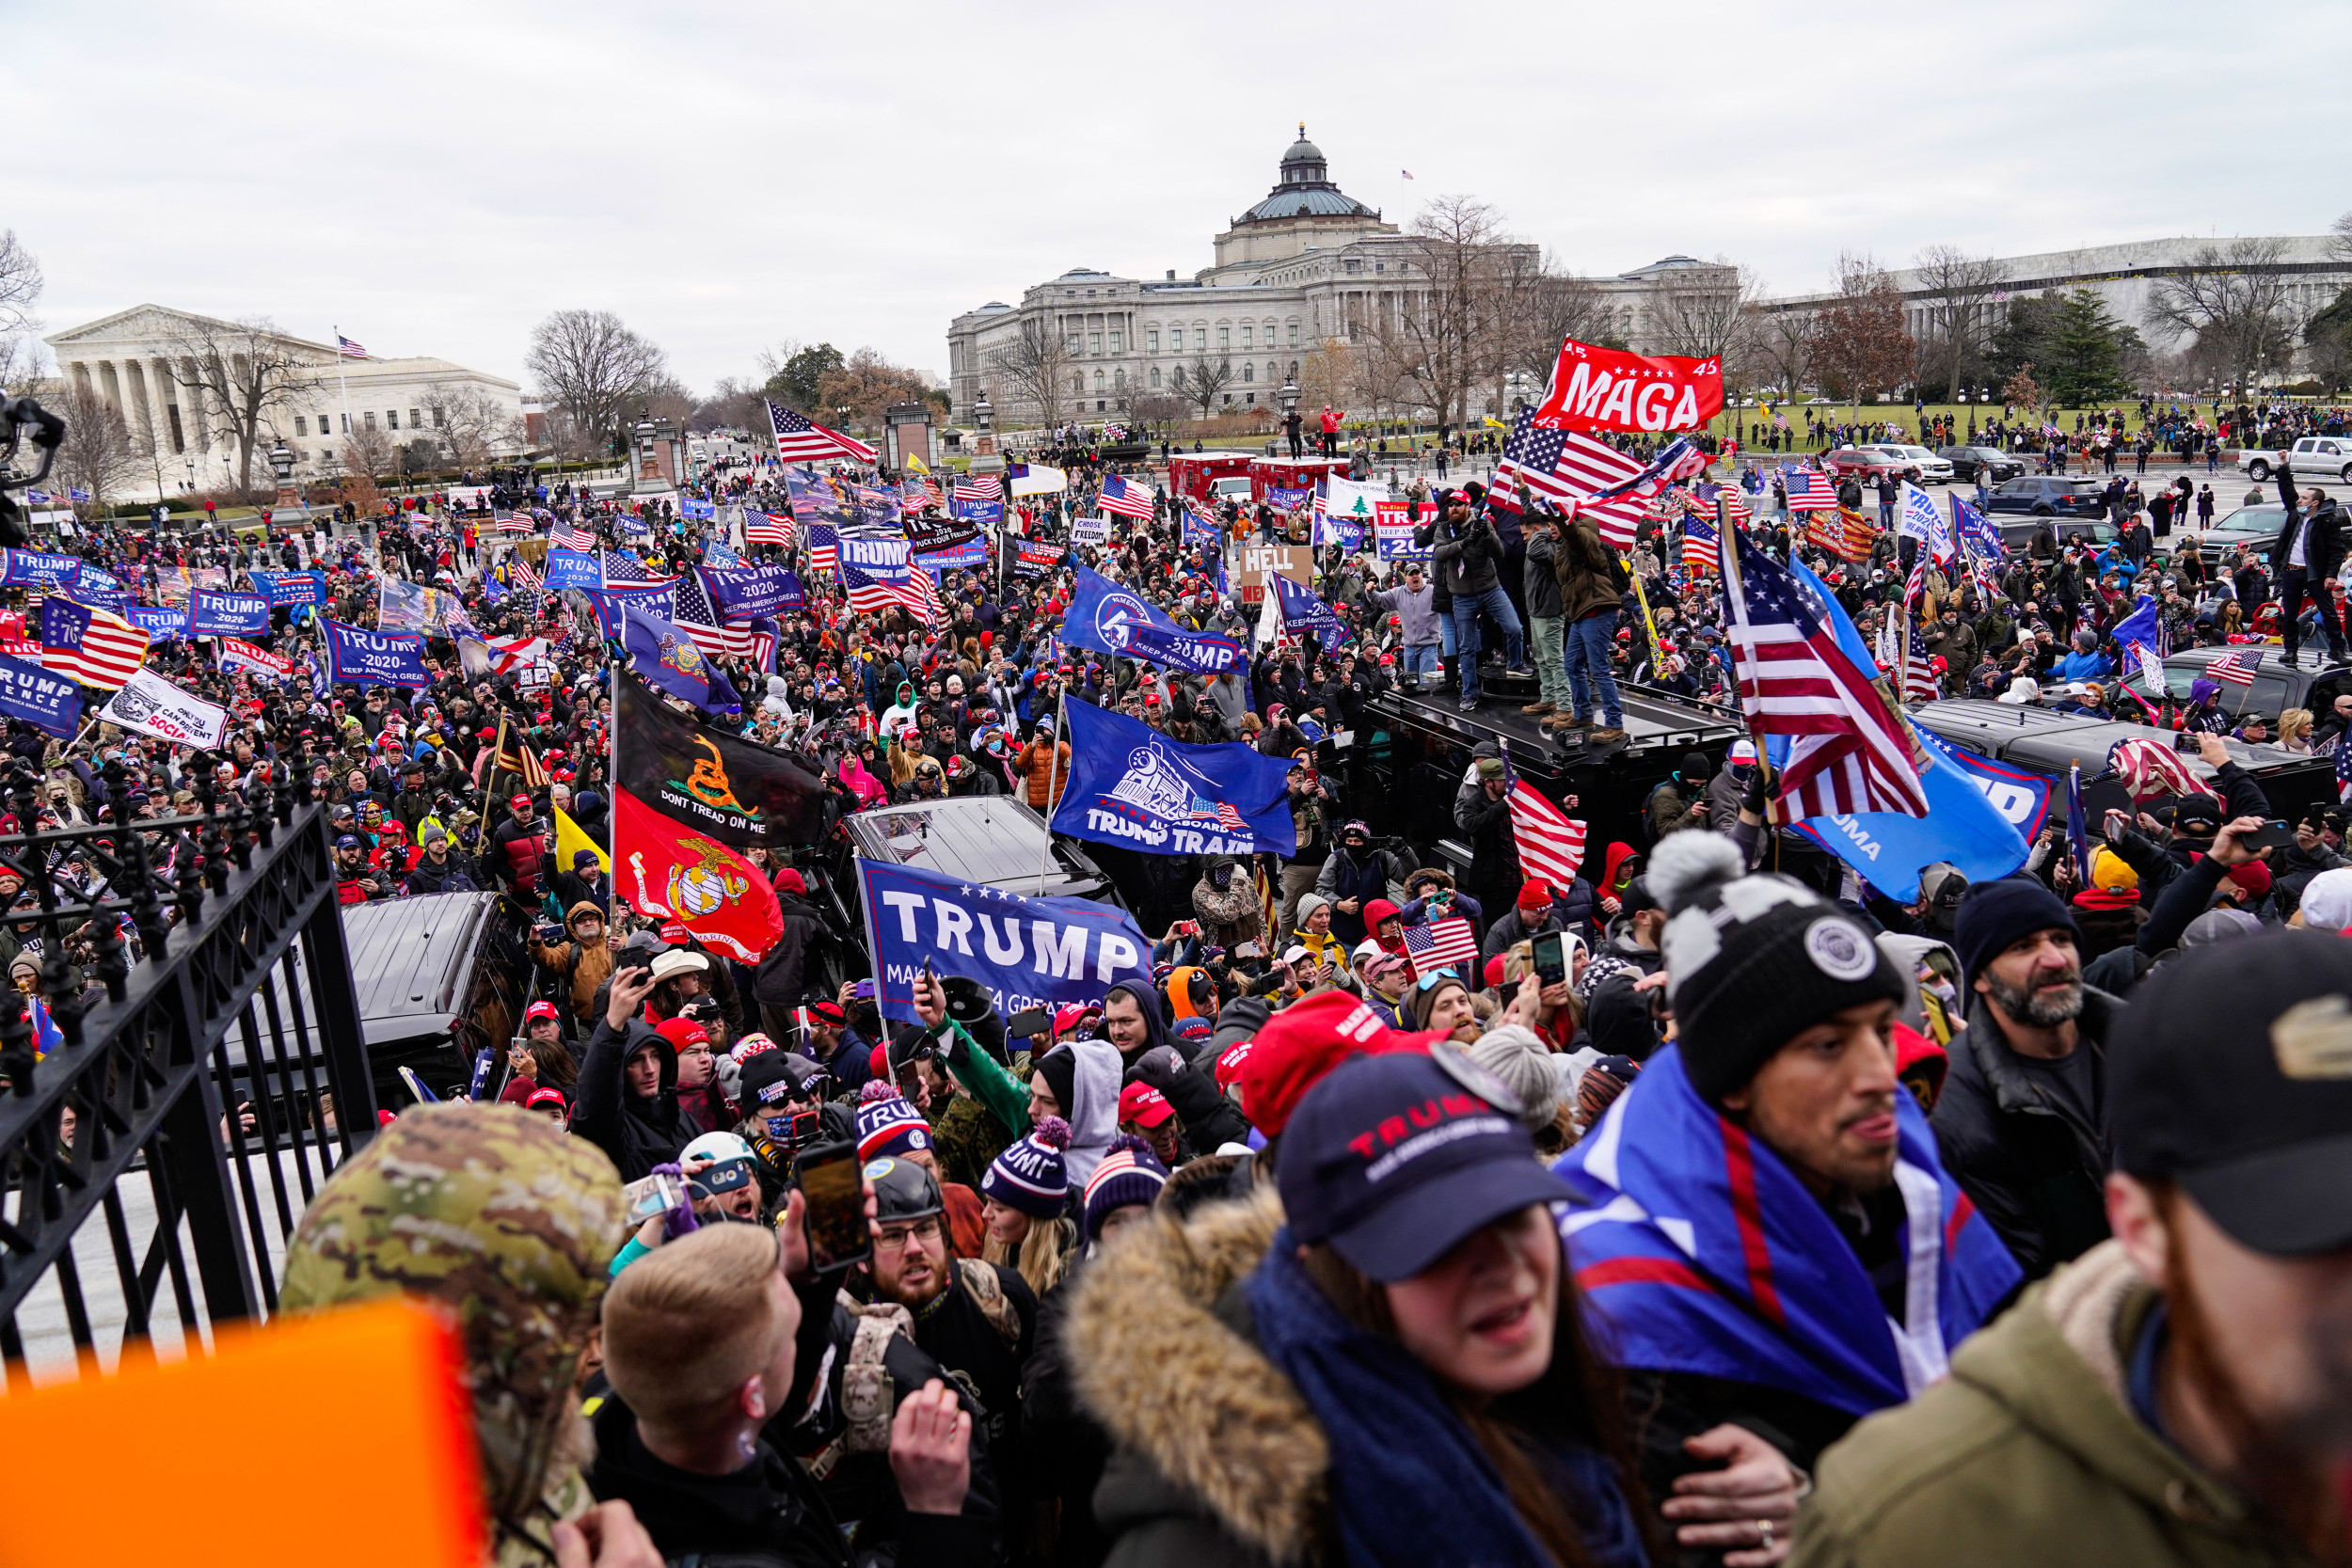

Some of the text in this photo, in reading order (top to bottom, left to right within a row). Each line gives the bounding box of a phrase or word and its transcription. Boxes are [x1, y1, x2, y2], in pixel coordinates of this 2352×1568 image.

[1565, 342, 1587, 358] 45
[1692, 359, 1717, 376] 45
[1561, 362, 1699, 431] MAGA
[1535, 416, 1562, 429] 45
[861, 506, 883, 516] TRUMP
[934, 527, 952, 536] 2020
[1077, 520, 1102, 529] CHOOSE
[915, 539, 932, 547] FUCK
[932, 534, 950, 545] YOUR
[1074, 530, 1104, 540] FREEDOM
[839, 538, 911, 565] TRUMP
[935, 546, 964, 557] 2020
[1016, 539, 1064, 558] TRUMP
[16, 554, 77, 572] TRUMP
[949, 554, 982, 563] BULLSHIT
[1245, 548, 1294, 572] HELL
[555, 558, 598, 576] TRUMP
[199, 594, 266, 613] TRUMP
[272, 591, 316, 606] 2020
[723, 593, 801, 613] KEEPING AMERICA GREAT!
[1112, 596, 1145, 619] AMERICA
[135, 613, 185, 626] TRUM
[61, 624, 78, 644] 76
[335, 627, 417, 653] TRUMP
[226, 641, 289, 670] TRUMP
[1136, 641, 1160, 656] KEEP
[365, 667, 398, 679] AMERICA
[0, 668, 74, 698] RUMP
[5, 686, 59, 708] ENCE
[25, 703, 40, 711] GREAT
[178, 707, 193, 721] ONLY
[162, 708, 213, 739] CAN PREVENT
[661, 789, 766, 834] DONT TREAD ON ME
[1152, 791, 1189, 818] 2020
[1087, 808, 1254, 855] TRUMP TRAIN
[1172, 820, 1229, 833] ABOARD
[695, 933, 737, 947] MARINE
[882, 890, 1138, 985] TRUMP
[1181, 1027, 1211, 1039] TRUMP
[1222, 1049, 1239, 1065] MAKE
[1229, 1051, 1248, 1068] GREAT
[757, 1080, 787, 1097] Trump
[767, 1091, 785, 1103] 2020
[1136, 1092, 1150, 1103] KEEP
[913, 1134, 923, 1144] 45
